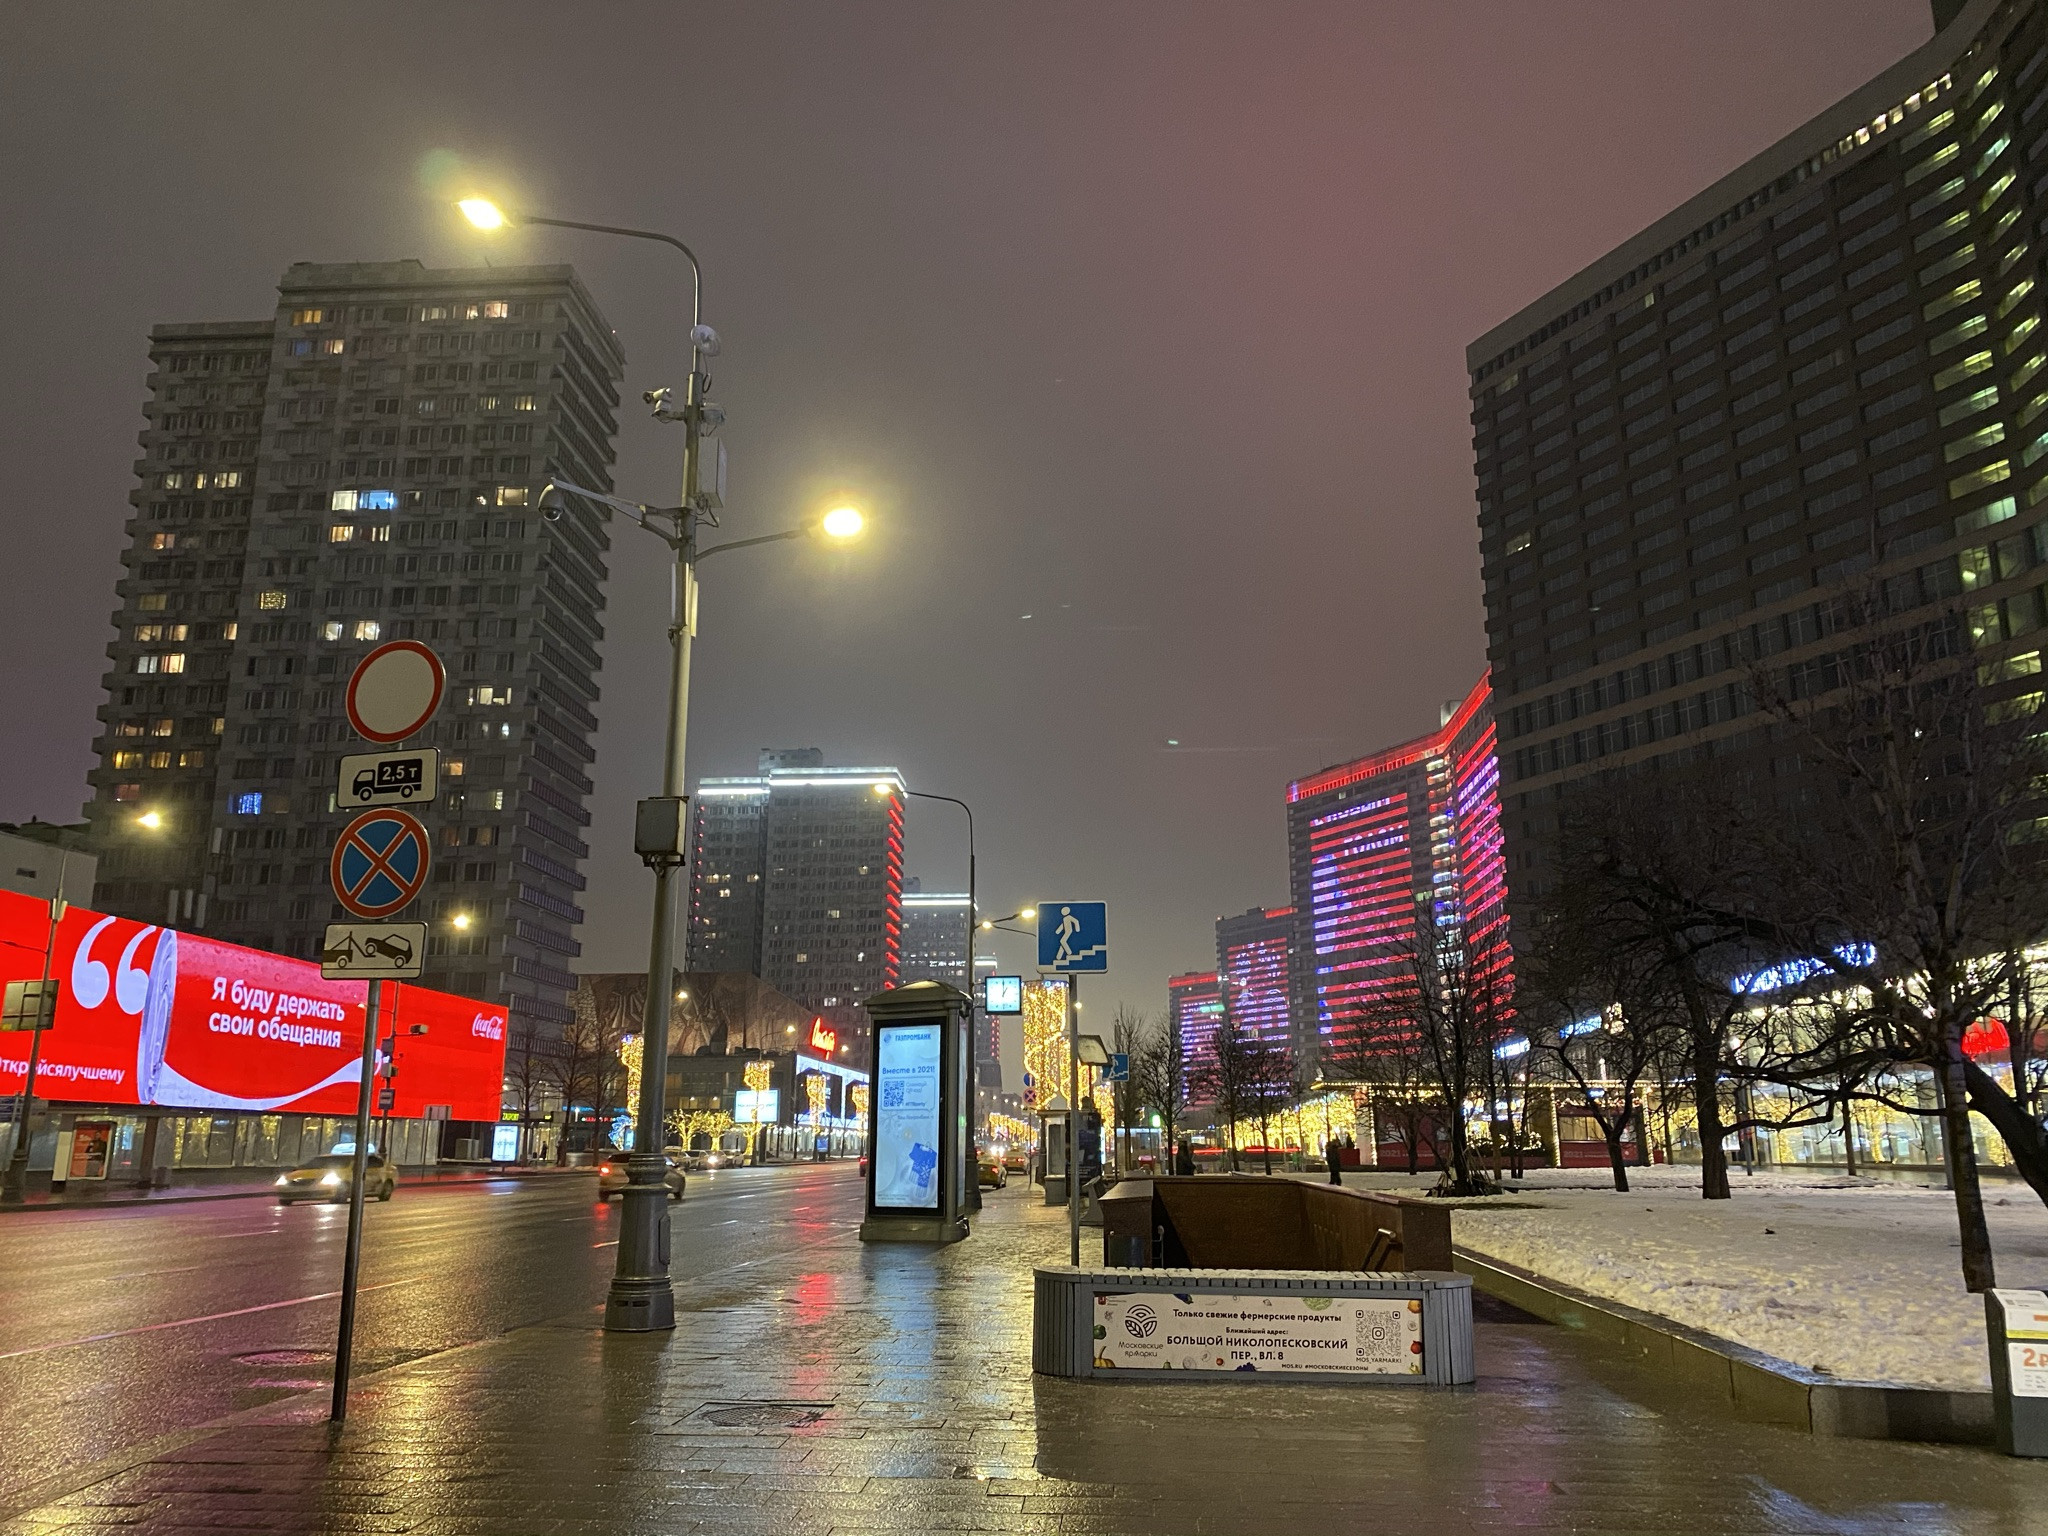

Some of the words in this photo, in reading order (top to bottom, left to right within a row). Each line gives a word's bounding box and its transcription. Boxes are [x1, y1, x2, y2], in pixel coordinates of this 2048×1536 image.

[382, 765, 406, 782] 2,5
[211, 976, 228, 1001] Я
[231, 980, 275, 1014] буду
[275, 994, 345, 1021] держать
[208, 1012, 255, 1036] свои
[258, 1016, 342, 1047] обещания
[895, 1033, 932, 1042] ГАЗПРОМБАНК
[0, 1056, 125, 1085] ткрйсялучшему
[882, 1067, 910, 1075] Вместе
[1173, 1309, 1204, 1318] Только
[1205, 1311, 1238, 1319] свежие
[1240, 1311, 1295, 1321] фермерские
[1297, 1314, 1342, 1323] продукты
[1226, 1327, 1265, 1335] Ближайший
[1118, 1341, 1164, 1350] Московские
[1167, 1335, 1223, 1347] БОЛЬШОЙ
[1226, 1337, 1348, 1349] НИКОЛОПЕСКОВСКИЙ
[1230, 1351, 1258, 1361] ПЕР.,
[1259, 1351, 1276, 1360] ВЛ.
[1277, 1351, 1284, 1360] 8
